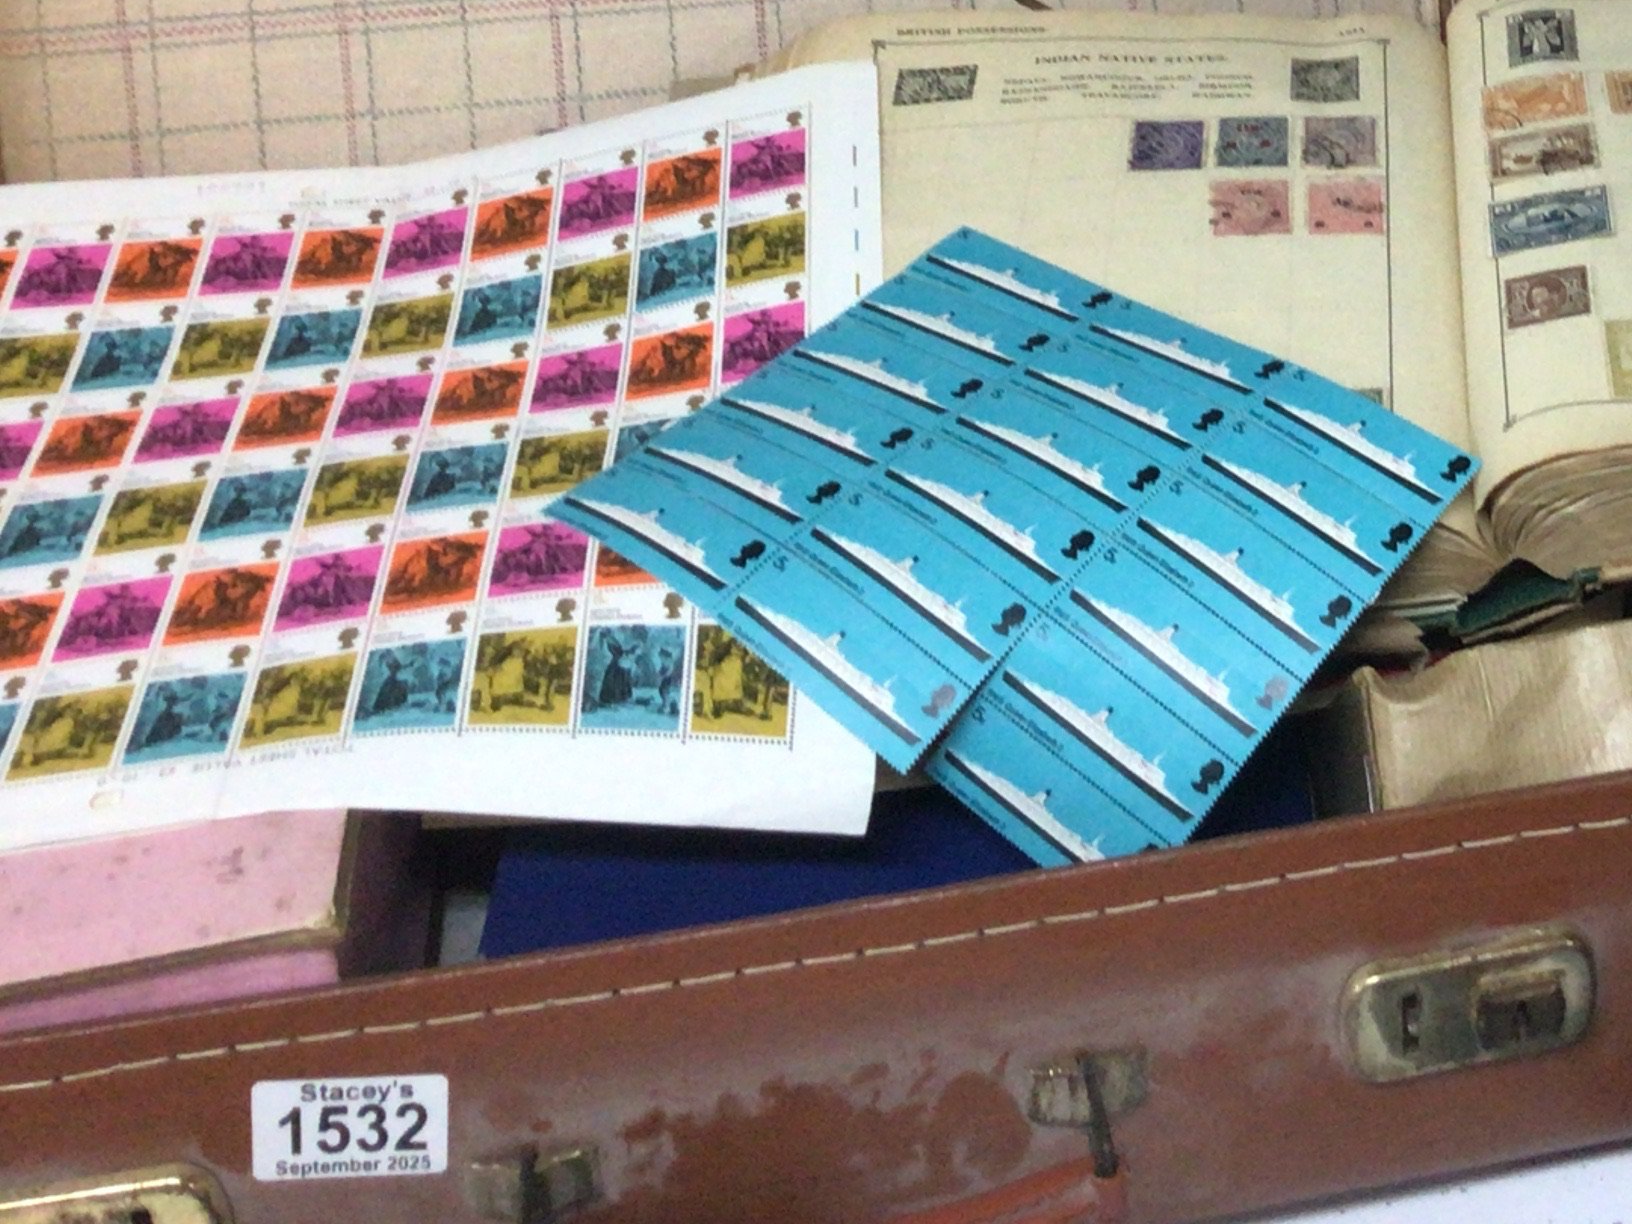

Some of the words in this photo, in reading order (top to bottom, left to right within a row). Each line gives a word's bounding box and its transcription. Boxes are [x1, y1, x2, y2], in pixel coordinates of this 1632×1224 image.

[300, 1080, 414, 1104] Stacey's
[278, 1101, 428, 1155] 1532
[275, 1158, 381, 1178] September
[387, 1155, 431, 1171] 2025
